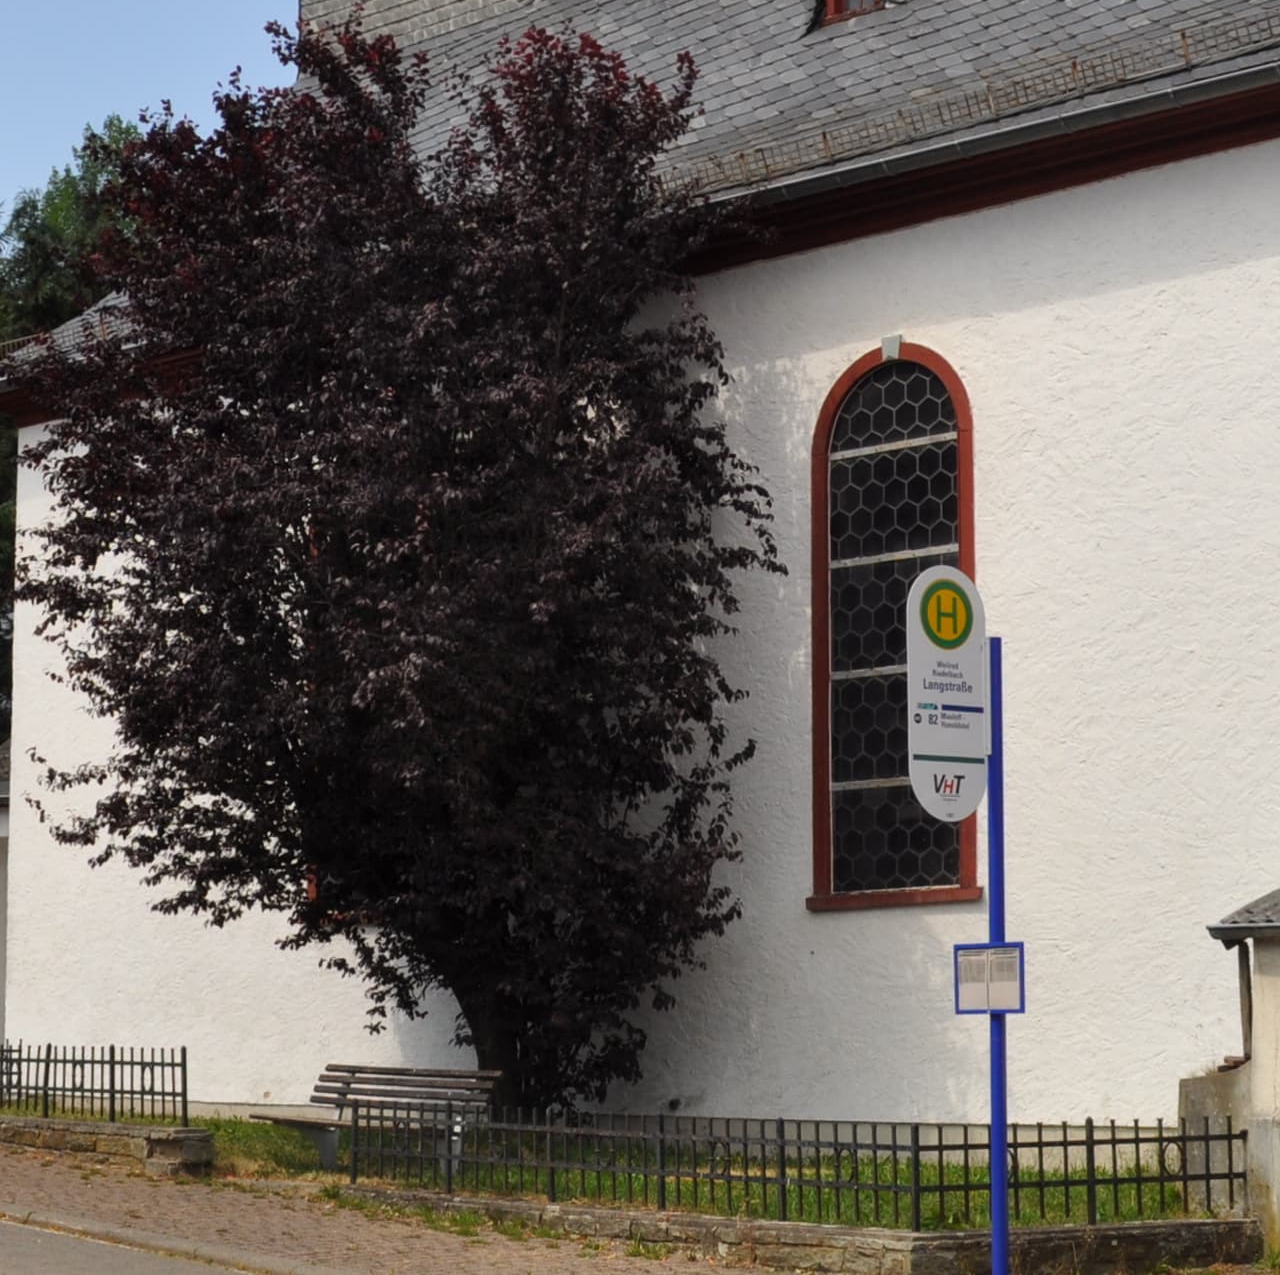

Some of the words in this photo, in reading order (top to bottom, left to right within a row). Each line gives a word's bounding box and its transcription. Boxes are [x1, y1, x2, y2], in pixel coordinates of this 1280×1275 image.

[936, 594, 958, 635] H
[923, 678, 973, 694] Langstraße
[933, 773, 966, 794] VHT
